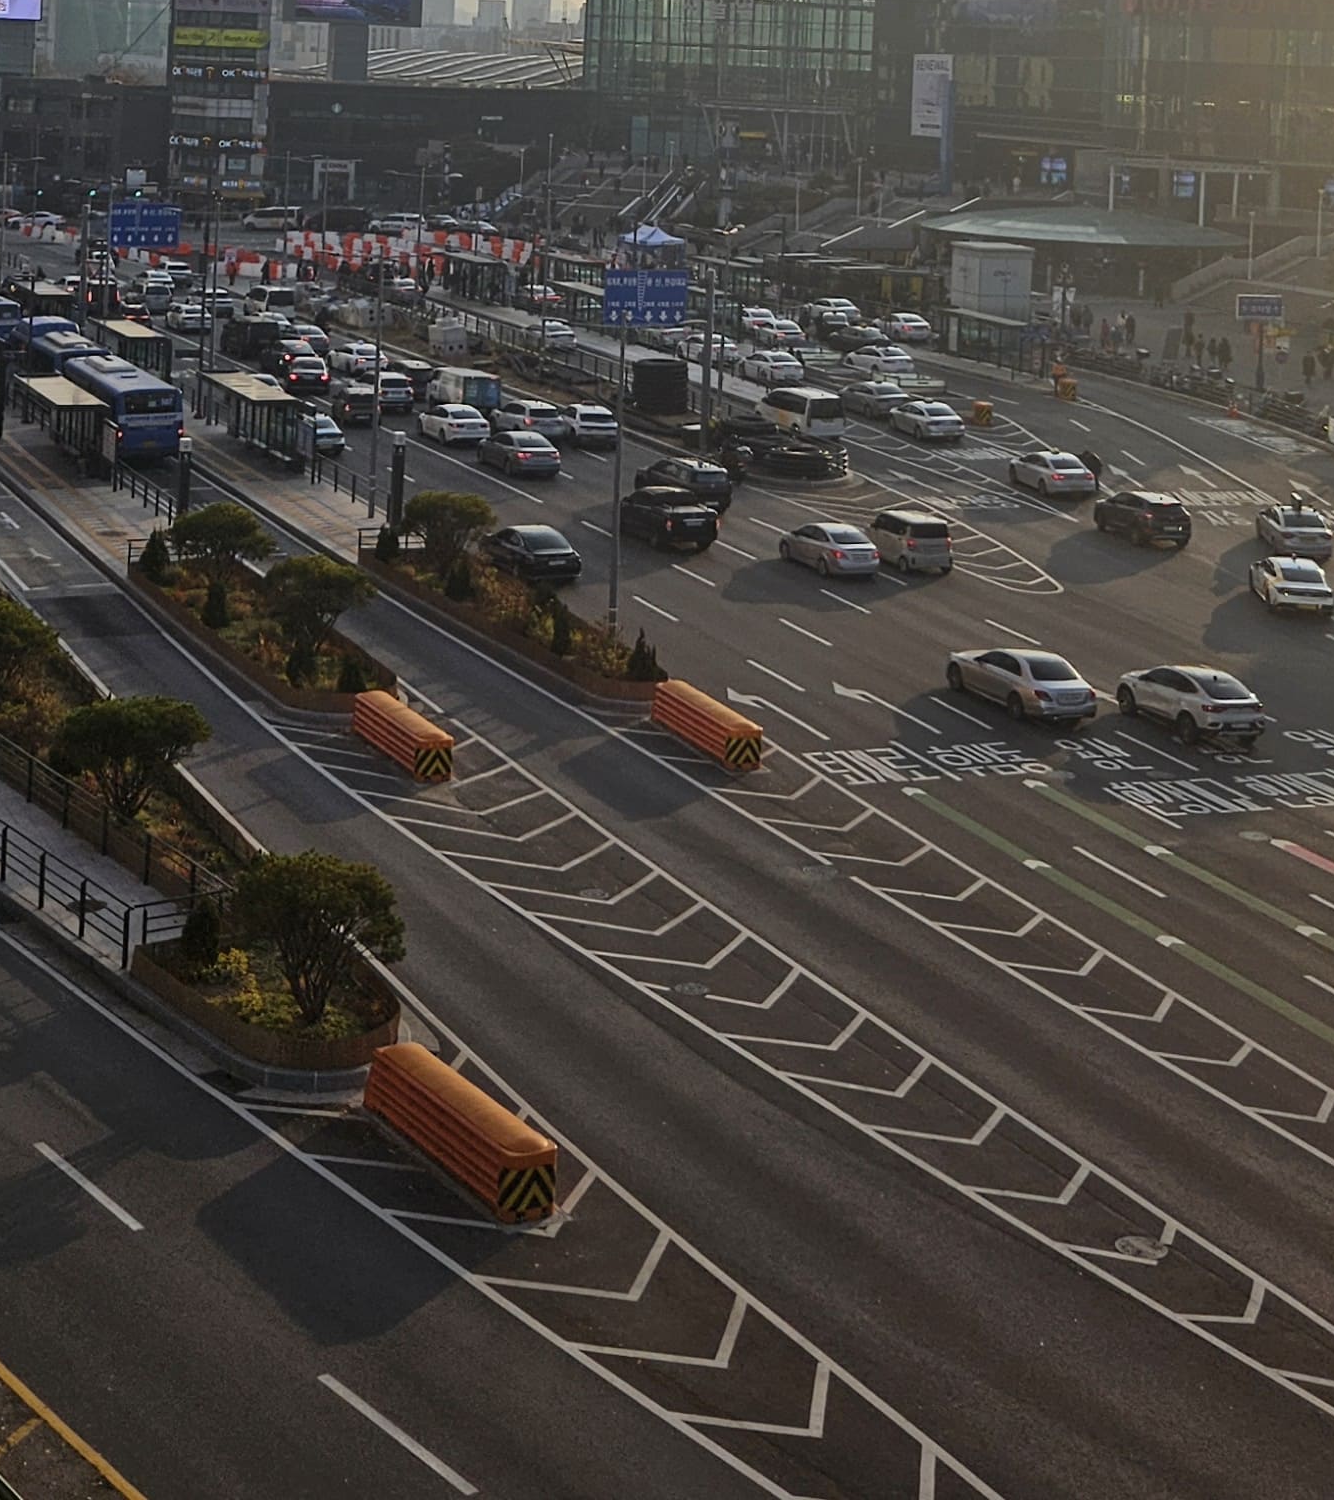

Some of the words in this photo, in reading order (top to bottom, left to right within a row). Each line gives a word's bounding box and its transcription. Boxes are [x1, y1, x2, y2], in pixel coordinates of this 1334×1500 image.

[802, 747, 941, 786] 퇴계로
[925, 741, 1054, 778] 후암동
[1109, 777, 1272, 816] 한강대로
